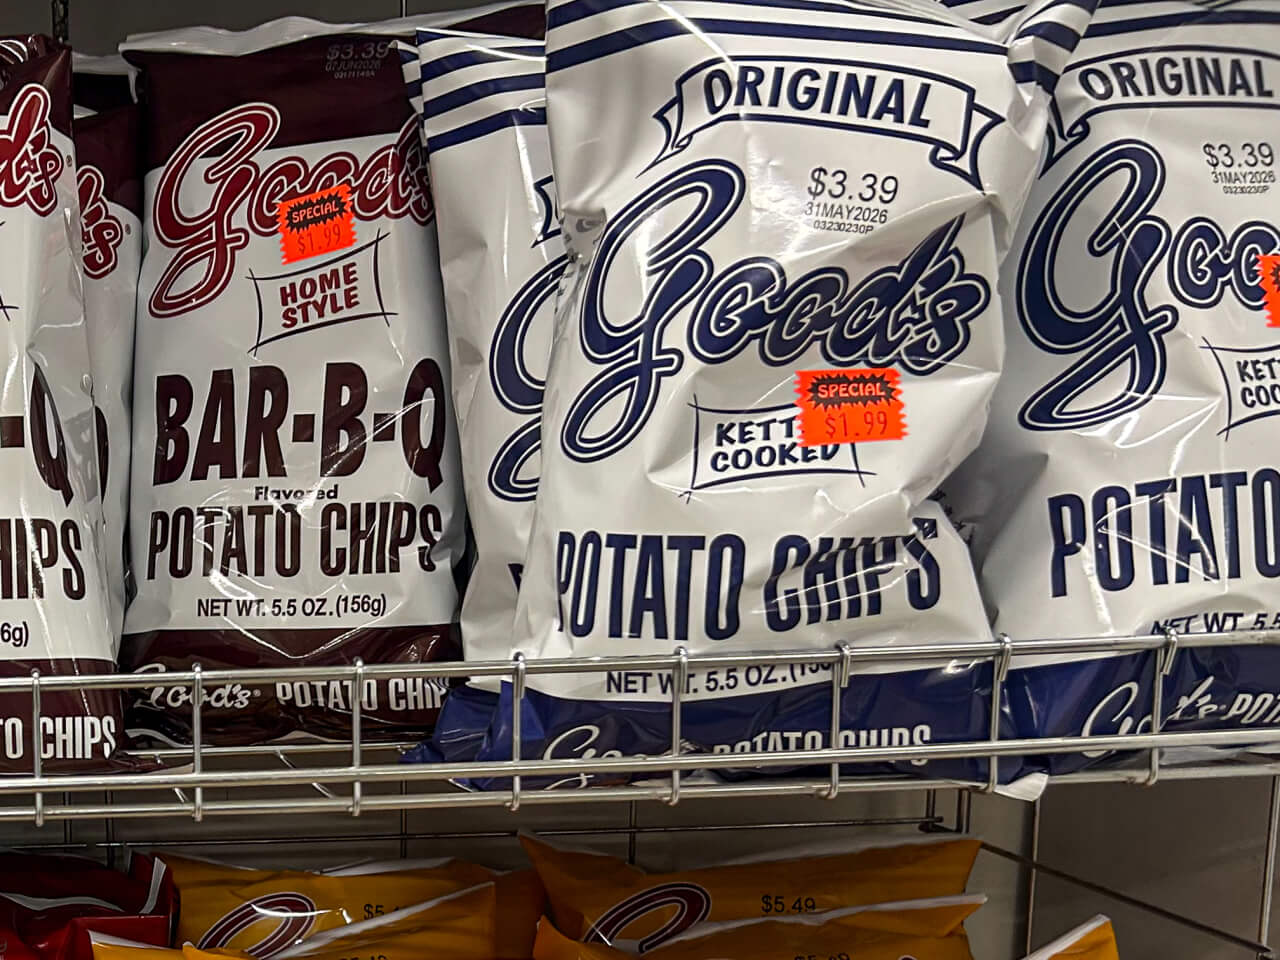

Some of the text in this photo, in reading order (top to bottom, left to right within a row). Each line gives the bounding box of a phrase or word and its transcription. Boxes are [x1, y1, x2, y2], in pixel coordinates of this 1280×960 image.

[1078, 48, 1274, 101] ORIGINAL
[704, 64, 932, 129] ORIGINAL
[1203, 142, 1274, 170] $3.39
[807, 166, 899, 205] $3.39
[290, 200, 341, 225] SPECIAL
[804, 201, 888, 224] 31MAY2026
[813, 219, 874, 235] 03230230P
[296, 224, 342, 257] $1.99
[279, 262, 359, 307] HOME
[1018, 139, 1280, 432] Goo
[280, 286, 361, 329] STYLE
[817, 382, 887, 399] SPECIAL
[153, 356, 448, 495] BAR-B-Q
[715, 415, 799, 448] KETT
[825, 410, 888, 439] $1.99
[710, 441, 841, 473] COOKED
[254, 484, 339, 502] Flavored
[147, 501, 442, 581] POTATO CHIPS
[1048, 470, 1280, 599] POTATO
[556, 518, 942, 643] POTATO CHIPS
[197, 594, 387, 618] NET WT. 5.5 OZ. (156g)
[275, 678, 377, 711] POTATO
[605, 670, 653, 694] NET
[658, 670, 699, 694] WT.
[704, 667, 739, 693] 5.5
[745, 663, 788, 688] OZ.
[38, 715, 117, 760] CHIPS
